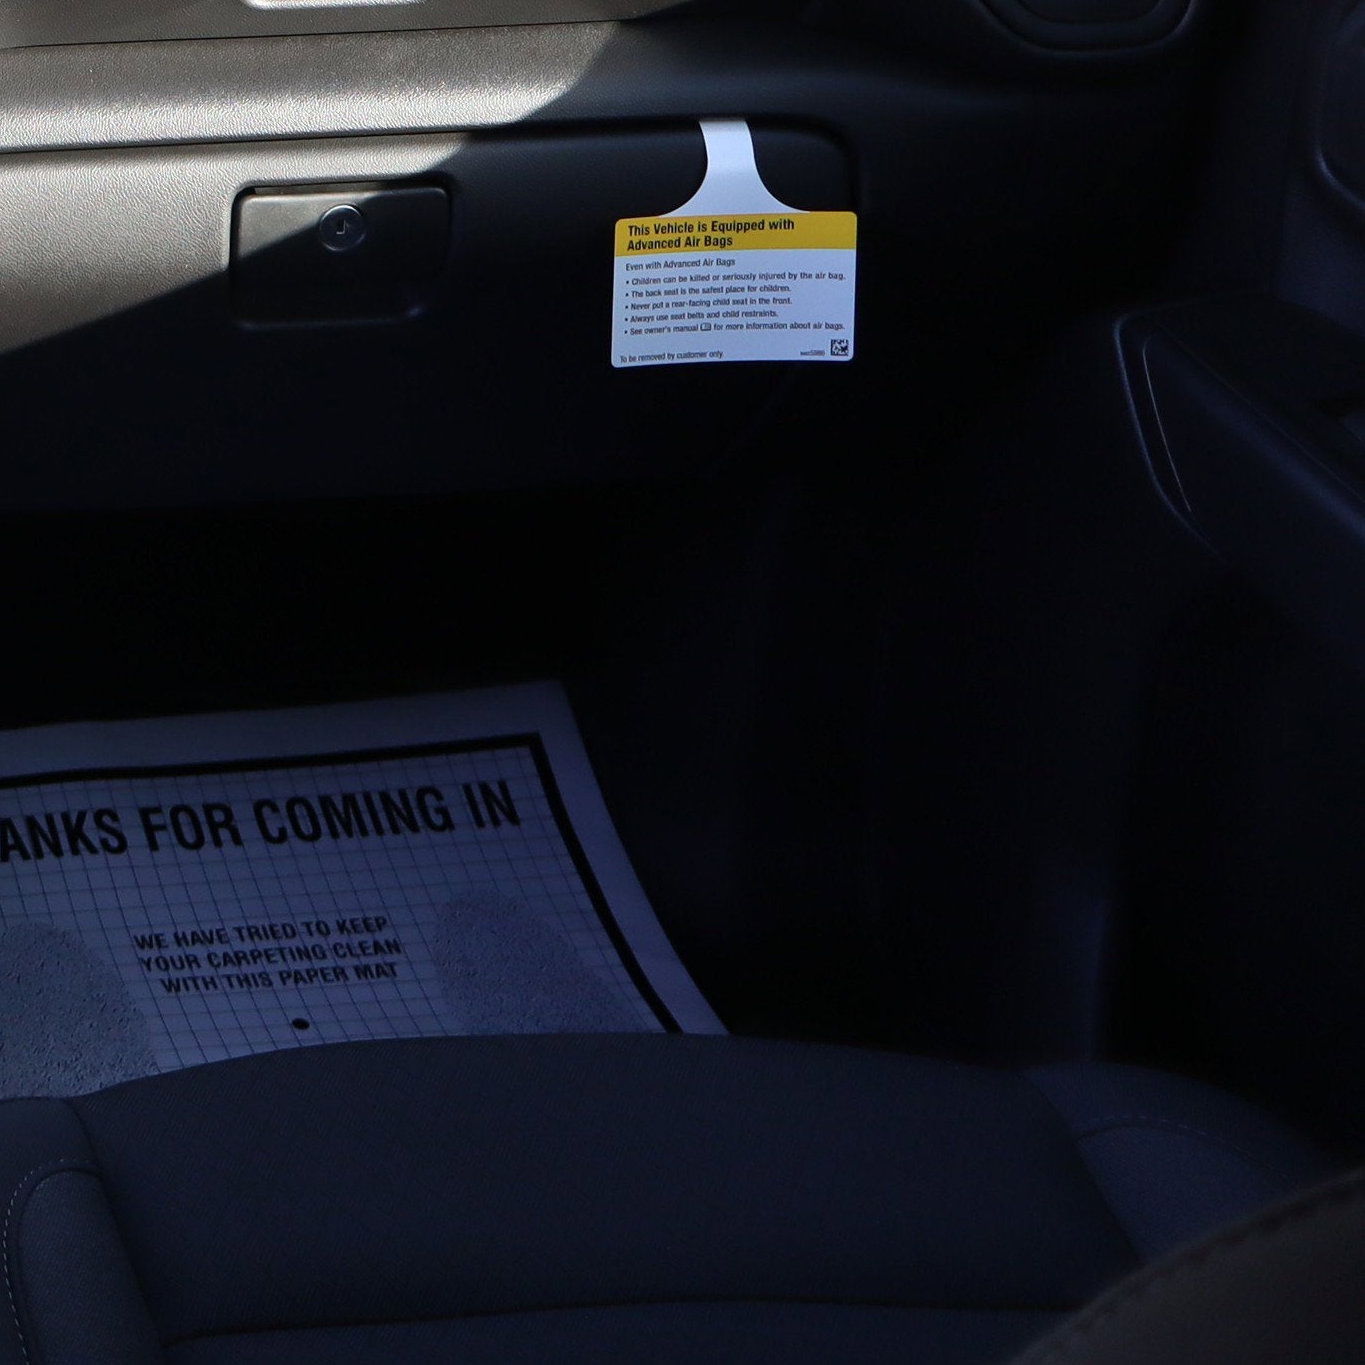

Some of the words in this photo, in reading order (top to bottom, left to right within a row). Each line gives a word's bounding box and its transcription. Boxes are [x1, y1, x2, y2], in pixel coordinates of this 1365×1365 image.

[628, 224, 650, 236] This
[654, 222, 694, 234] Vehicle
[697, 221, 707, 232] is
[711, 219, 765, 233] Equipped
[769, 219, 795, 230] with
[627, 236, 681, 251] Advanced
[684, 236, 701, 247] Air
[704, 235, 733, 248] Bags
[625, 263, 643, 271] Even
[645, 261, 661, 270] with
[663, 259, 701, 269] Advanced
[702, 258, 714, 267] Air
[715, 258, 736, 267] Bags
[631, 276, 661, 286] Children
[663, 276, 676, 284] can
[678, 275, 688, 283] be
[689, 274, 710, 282] killed
[722, 272, 756, 282] seriously
[758, 272, 786, 281] injured
[788, 271, 798, 280] by
[800, 271, 813, 279] the
[828, 271, 846, 281] bag.
[631, 290, 644, 298] The
[645, 289, 662, 297] back
[663, 288, 679, 296] seat
[680, 287, 686, 295] is
[701, 286, 724, 294] safest
[725, 285, 746, 294] place
[759, 284, 792, 293] children.
[630, 303, 650, 311] Never
[652, 301, 664, 310] put
[671, 299, 710, 309] rear-facing
[712, 298, 730, 306] child
[749, 297, 757, 305] in
[630, 315, 655, 323] Always
[687, 311, 705, 319] belts
[706, 311, 720, 319] and
[722, 310, 740, 318] child
[741, 309, 779, 317] restraints.
[630, 327, 642, 335] See
[672, 324, 699, 333] manual
[745, 322, 788, 330] information
[789, 322, 811, 330] about
[824, 322, 845, 331] bags.
[620, 355, 627, 363] To
[629, 354, 637, 362] be
[638, 352, 666, 361] removed
[667, 352, 676, 361] by
[676, 350, 708, 359] customer
[137, 802, 244, 853] FOR
[252, 786, 456, 845] COMING
[462, 779, 521, 830] IN
[134, 933, 169, 951] WE
[173, 927, 231, 948] HAVE
[232, 922, 297, 943] TRIED
[301, 919, 331, 938] TO
[335, 915, 388, 935] KEEP
[139, 953, 202, 973] YOUR
[207, 943, 328, 969] CARPETING
[332, 938, 403, 958] CLEAN
[159, 976, 219, 995] WITH
[222, 971, 273, 990] THIS
[278, 965, 349, 986] PAPER
[354, 961, 399, 981] MAT
